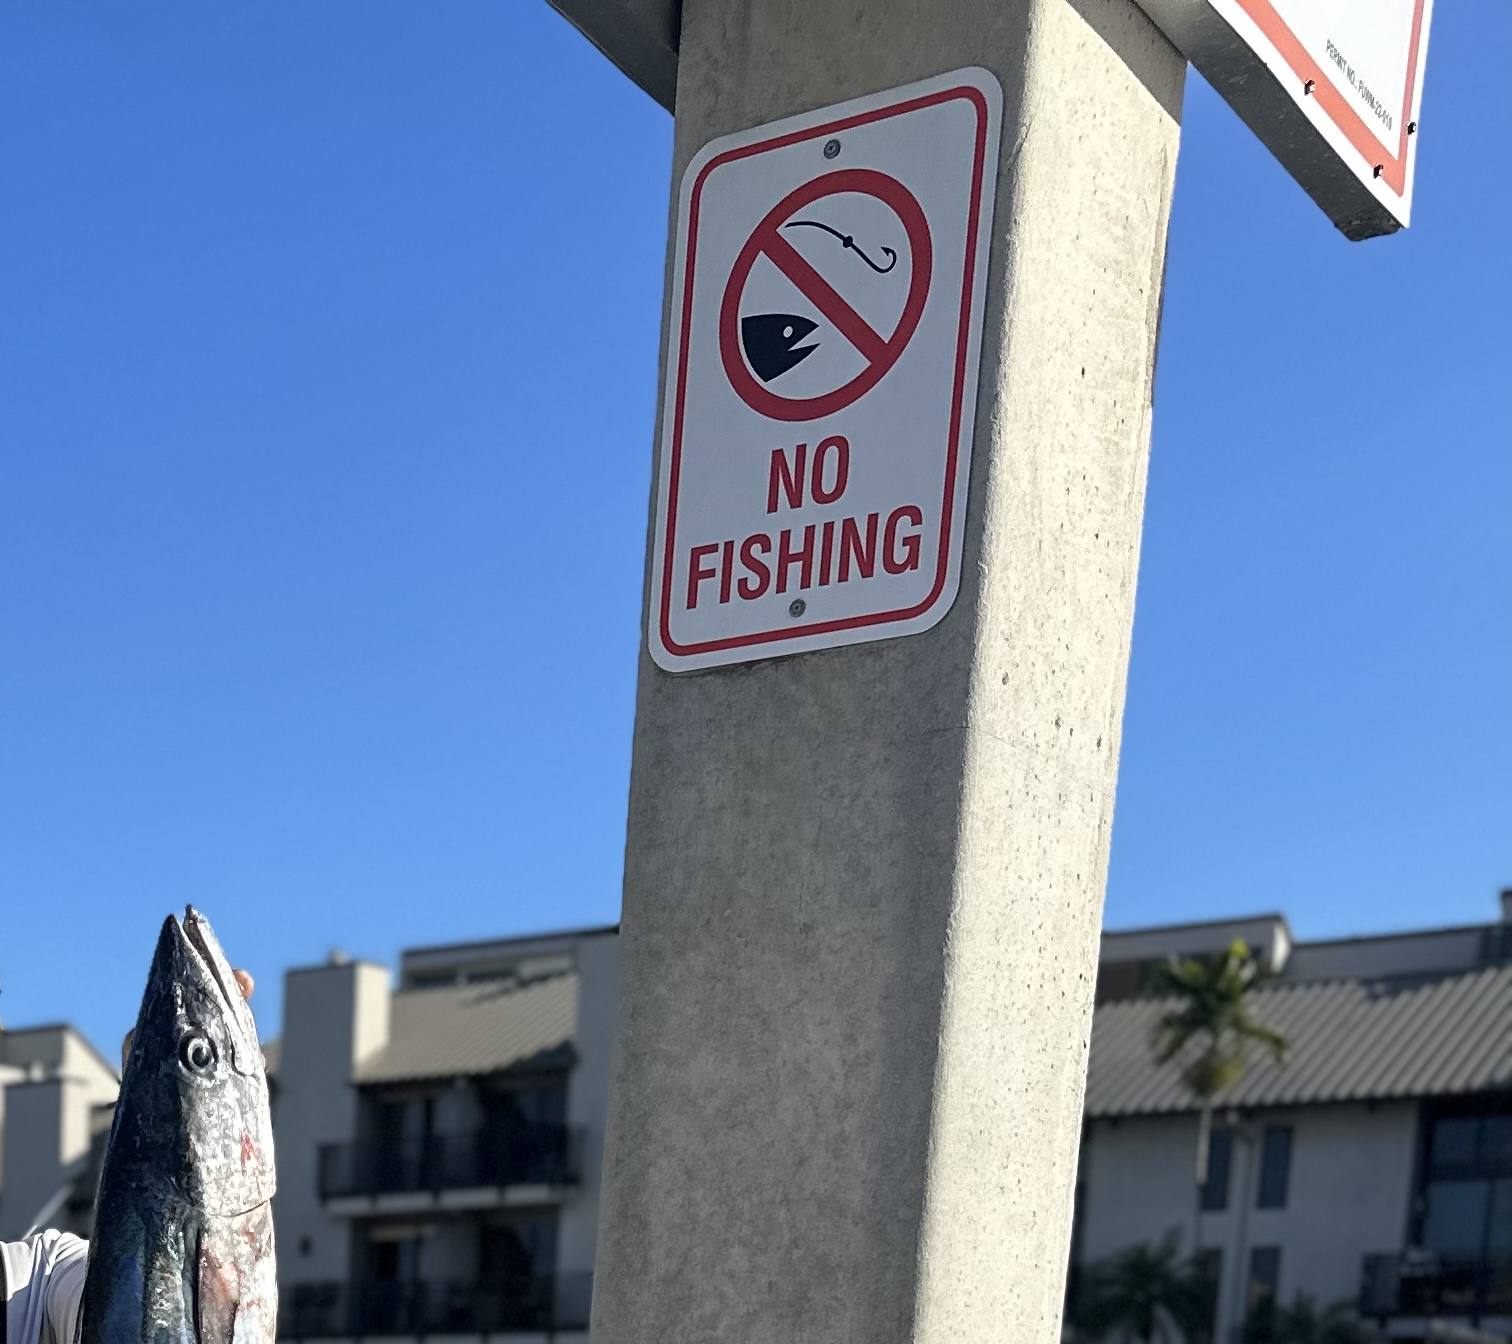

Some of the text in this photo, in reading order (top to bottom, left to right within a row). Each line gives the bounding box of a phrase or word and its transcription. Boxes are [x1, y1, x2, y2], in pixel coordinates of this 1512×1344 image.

[1326, 38, 1347, 74] PERMIT
[766, 435, 850, 514] NO
[686, 505, 923, 610] FISHING
